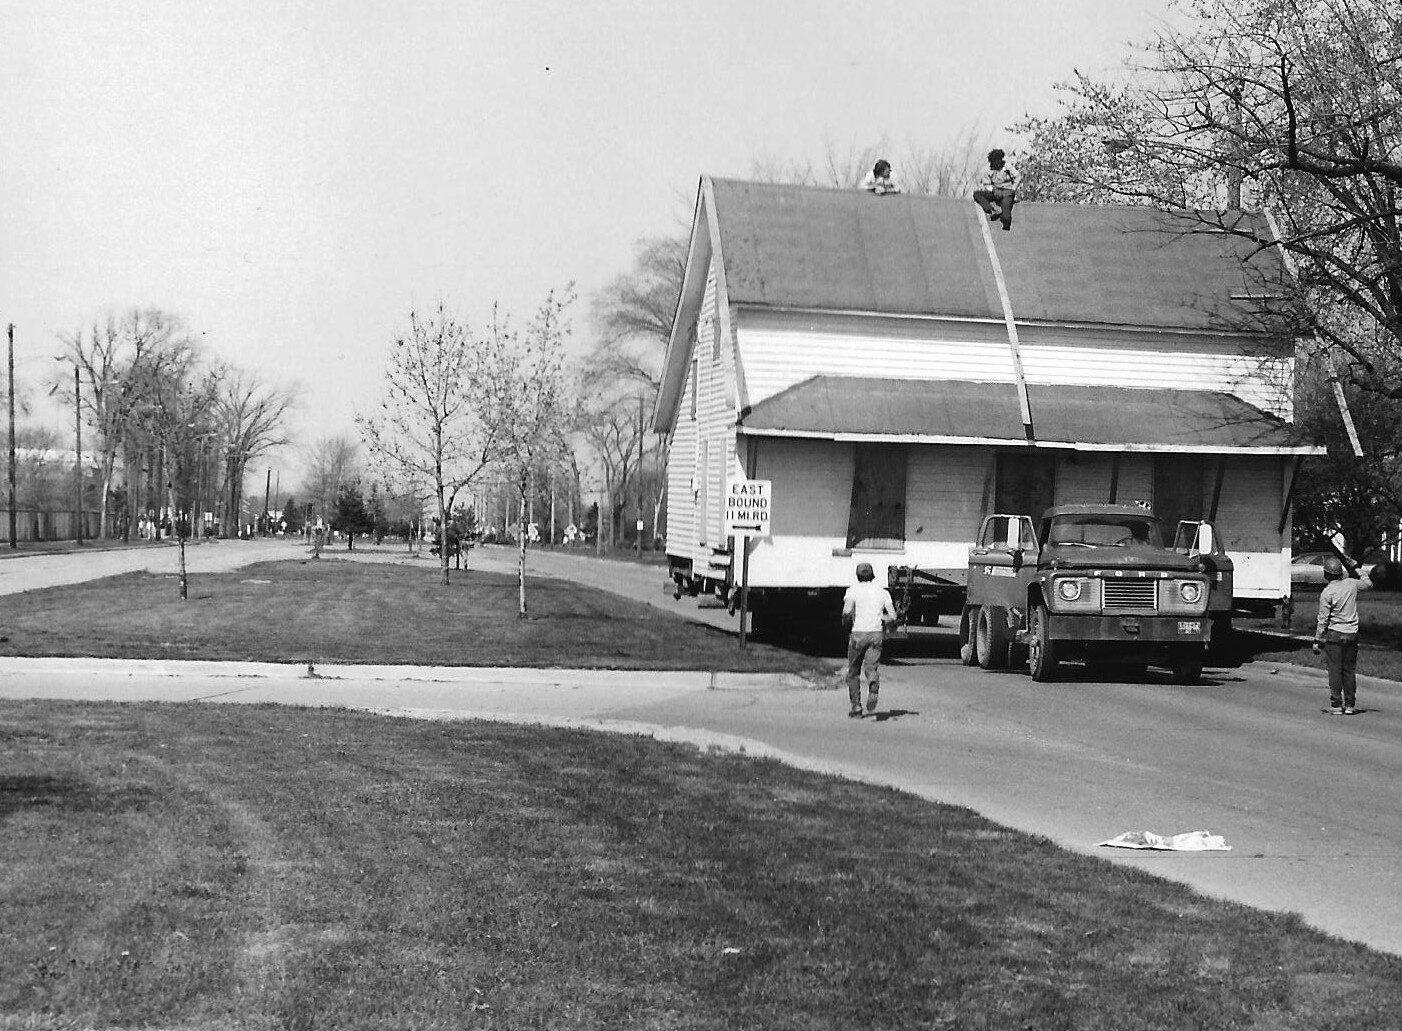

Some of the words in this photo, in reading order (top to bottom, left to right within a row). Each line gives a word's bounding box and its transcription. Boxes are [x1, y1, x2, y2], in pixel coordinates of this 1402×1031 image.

[732, 484, 763, 495] EAST
[728, 497, 768, 508] BOUND
[1093, 570, 1168, 578] FORD
